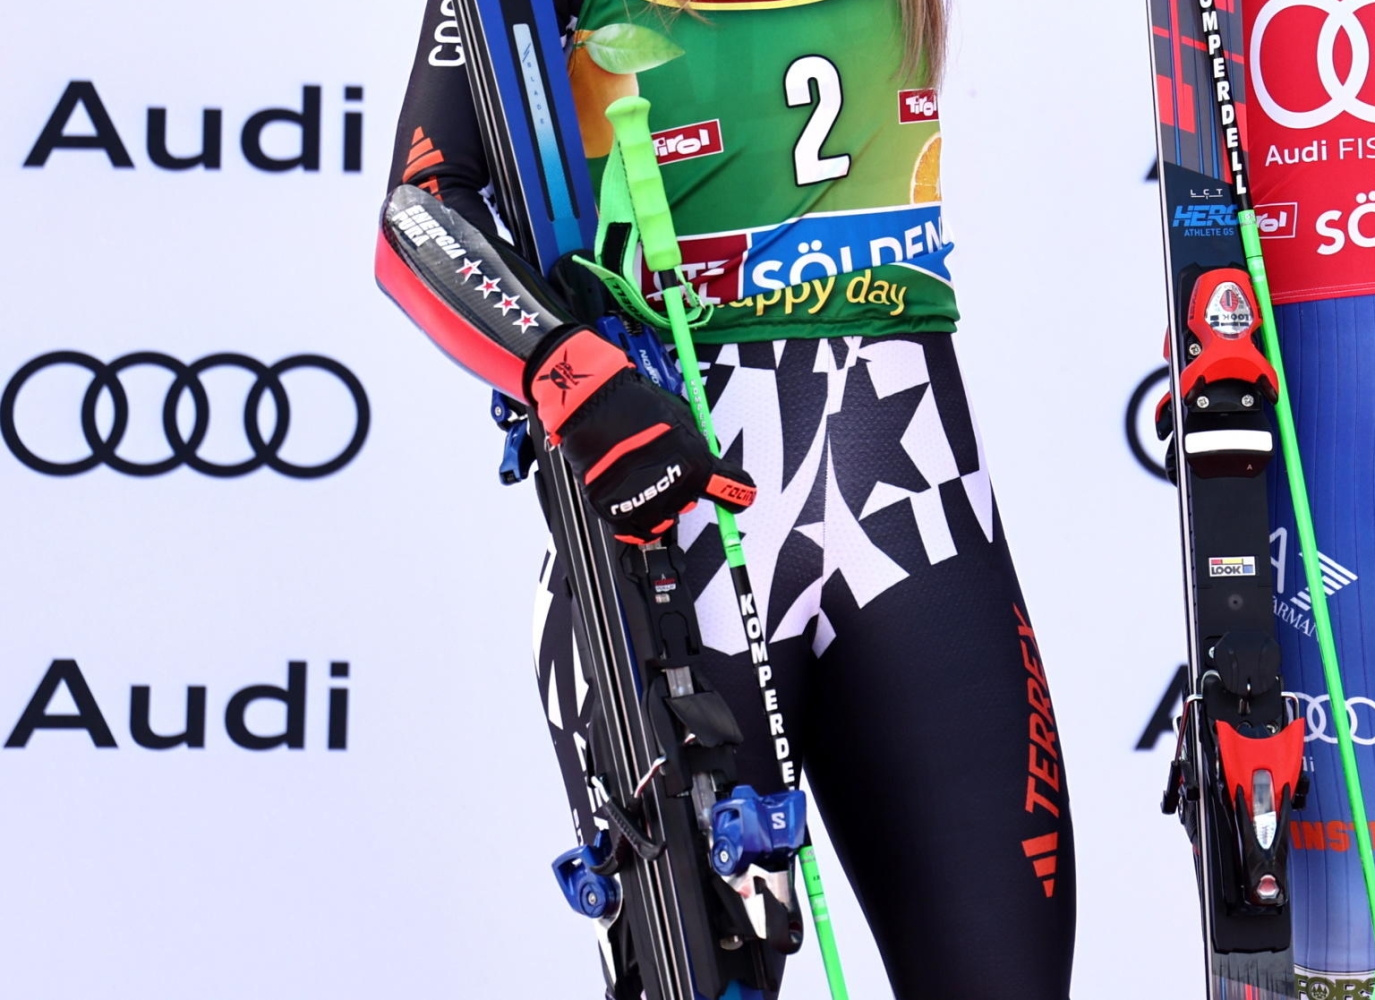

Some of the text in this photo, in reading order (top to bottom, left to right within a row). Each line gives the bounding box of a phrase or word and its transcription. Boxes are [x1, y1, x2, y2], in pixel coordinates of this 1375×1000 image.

[22, 80, 364, 173] Audi
[784, 54, 851, 187] 2
[905, 94, 937, 117] Tirol
[1265, 138, 1328, 167] Audi
[406, 204, 467, 260] ENERGIA
[1184, 227, 1235, 237] ATHLETE GS
[1257, 212, 1287, 232] rol
[846, 269, 908, 316] day
[610, 463, 682, 516] reusch
[1211, 564, 1242, 575] LOOK
[3, 658, 350, 752] Audi
[740, 594, 797, 790] KOMPERDE
[1012, 601, 1060, 818] TERREX
